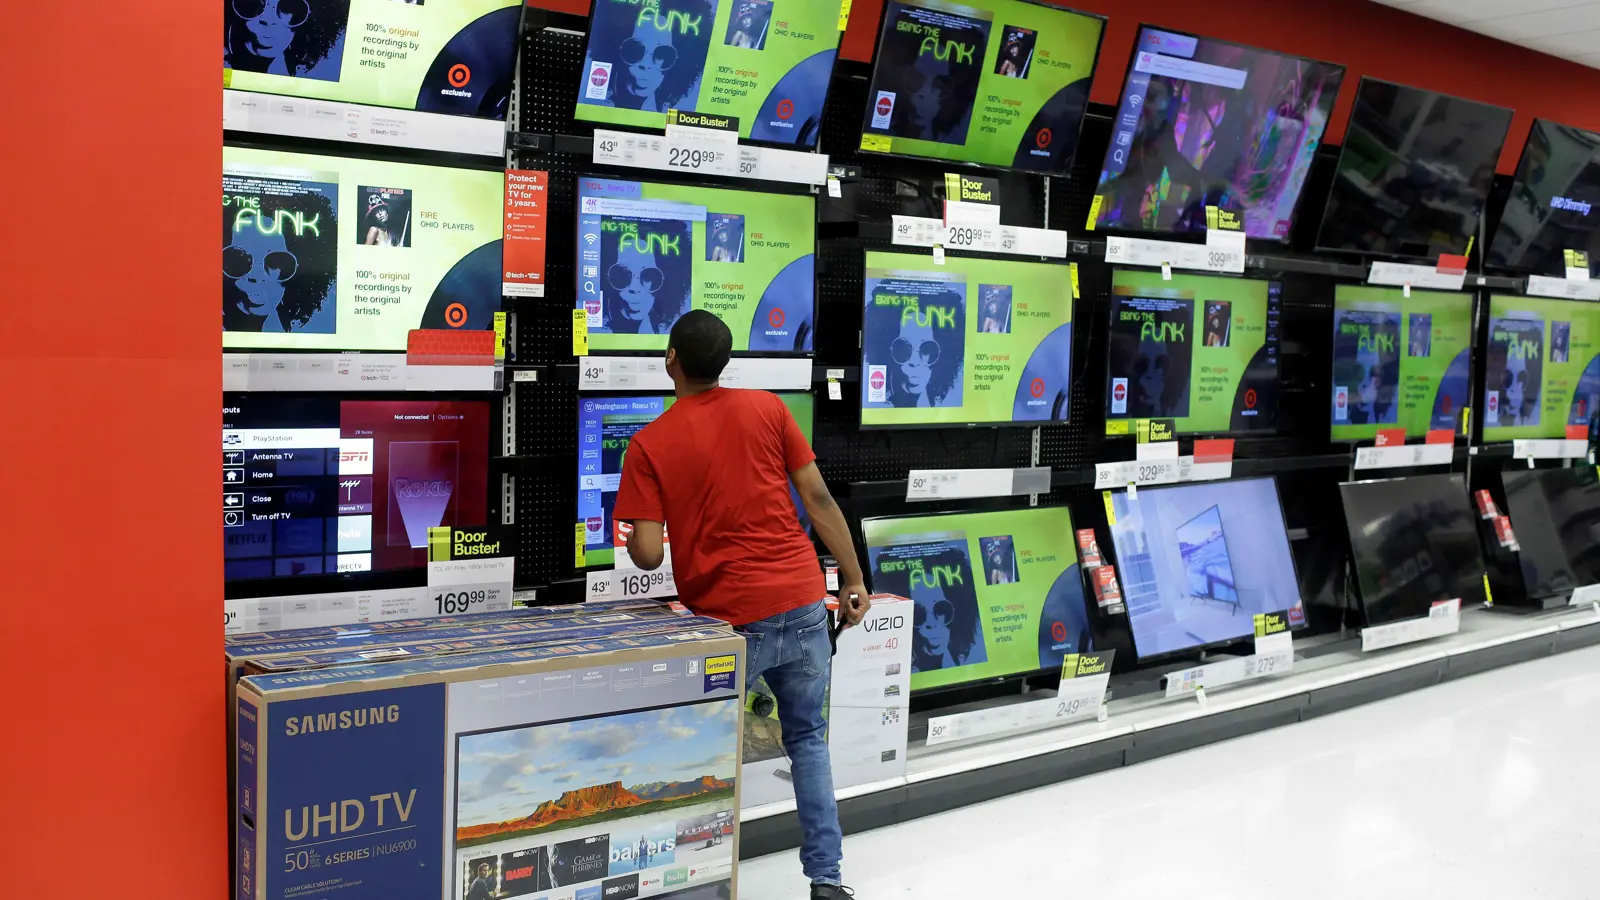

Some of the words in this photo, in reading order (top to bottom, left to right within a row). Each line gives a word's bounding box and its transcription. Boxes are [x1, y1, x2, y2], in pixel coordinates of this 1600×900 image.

[637, 7, 702, 36] FUNK
[776, 21, 789, 29] FIRE
[366, 23, 387, 34] 100%
[388, 26, 420, 38] original
[774, 28, 788, 36] OHIO
[790, 32, 815, 41] PLAYERS
[897, 21, 923, 34] BRING
[924, 25, 940, 37] THE
[363, 34, 408, 49] recordings
[409, 41, 420, 51] by
[362, 46, 375, 56] the
[376, 48, 407, 60] original
[920, 37, 976, 65] FUNK
[360, 58, 386, 69] artists
[718, 66, 734, 75] 100%
[735, 68, 759, 78] original
[715, 76, 748, 88] recordings
[748, 80, 758, 89] by
[441, 88, 472, 98] exclusive
[713, 86, 723, 94] the
[724, 88, 748, 98] original
[710, 96, 731, 105] artists
[1002, 98, 1022, 108] original
[985, 106, 1013, 116] recordings
[1014, 110, 1021, 118] by
[679, 113, 699, 125] Door
[700, 116, 729, 128] Buster!
[770, 120, 794, 128] exclusive
[992, 117, 1012, 127] original
[600, 141, 618, 152] 43"
[740, 163, 757, 173] 50"
[508, 174, 537, 183] Protect
[962, 178, 983, 190] Door
[508, 183, 526, 191] your
[586, 182, 603, 190] TCL
[962, 188, 992, 201] Buster!
[232, 196, 261, 208] THE
[586, 199, 597, 207] 4K
[1219, 210, 1235, 219] Door
[236, 208, 320, 237] FUNK
[420, 220, 439, 229] OHIO
[442, 222, 475, 231] PLAYERS
[618, 222, 638, 233] THE
[1219, 218, 1241, 229] Buster!
[620, 232, 679, 256] FUNK
[750, 240, 765, 248] OHIO
[766, 241, 790, 249] PLAYERS
[356, 270, 377, 280] 100%
[379, 271, 411, 282] original
[354, 283, 400, 294] recordings
[402, 284, 412, 295] by
[354, 294, 368, 304] the
[370, 295, 401, 307] original
[704, 292, 737, 301] recordings
[876, 295, 900, 305] BRING
[900, 296, 919, 307] THE
[354, 306, 381, 316] artists
[714, 302, 738, 311] original
[901, 306, 956, 328] FUNK
[1120, 312, 1141, 321] BRING
[1142, 312, 1156, 321] THE
[1141, 322, 1185, 342] FUNK
[1358, 334, 1394, 353] FUNK
[990, 354, 1010, 362] original
[584, 367, 604, 379] 43"
[974, 363, 1003, 372] recordings
[1004, 364, 1011, 372] by
[984, 374, 1004, 382] original
[974, 383, 991, 391] artists
[594, 403, 628, 411] Westinghouse
[1151, 422, 1166, 431] Door
[1151, 430, 1172, 440] Buster!
[912, 478, 927, 489] 50"
[454, 531, 487, 543] Door
[454, 542, 500, 556] Buster!
[880, 562, 905, 573] BRING
[905, 560, 923, 570] THE
[910, 564, 964, 590] FUNK
[592, 582, 610, 593] 43"
[992, 614, 1020, 624] recordings
[1020, 613, 1028, 622] by
[1266, 616, 1279, 624] Door
[864, 616, 904, 633] VIZIO
[994, 626, 1002, 634] the
[1003, 624, 1022, 633] original
[1266, 622, 1286, 633] Buster!
[996, 635, 1012, 643] artists
[242, 640, 338, 652] SAMSUNG
[1080, 656, 1100, 666] Door
[1078, 663, 1105, 675] Buster!
[272, 669, 376, 684] SAMSUNG
[286, 704, 400, 737] SAMSUNG
[932, 726, 947, 736] 50"
[284, 799, 365, 841] UHD
[370, 789, 417, 827] TV
[284, 849, 315, 873] 50"
[325, 855, 332, 865] 6
[333, 848, 370, 864] SERIES
[376, 840, 417, 856] NU6900
[574, 854, 596, 865] GAME
[571, 862, 603, 874] THRONES
[667, 872, 685, 882] hulu
